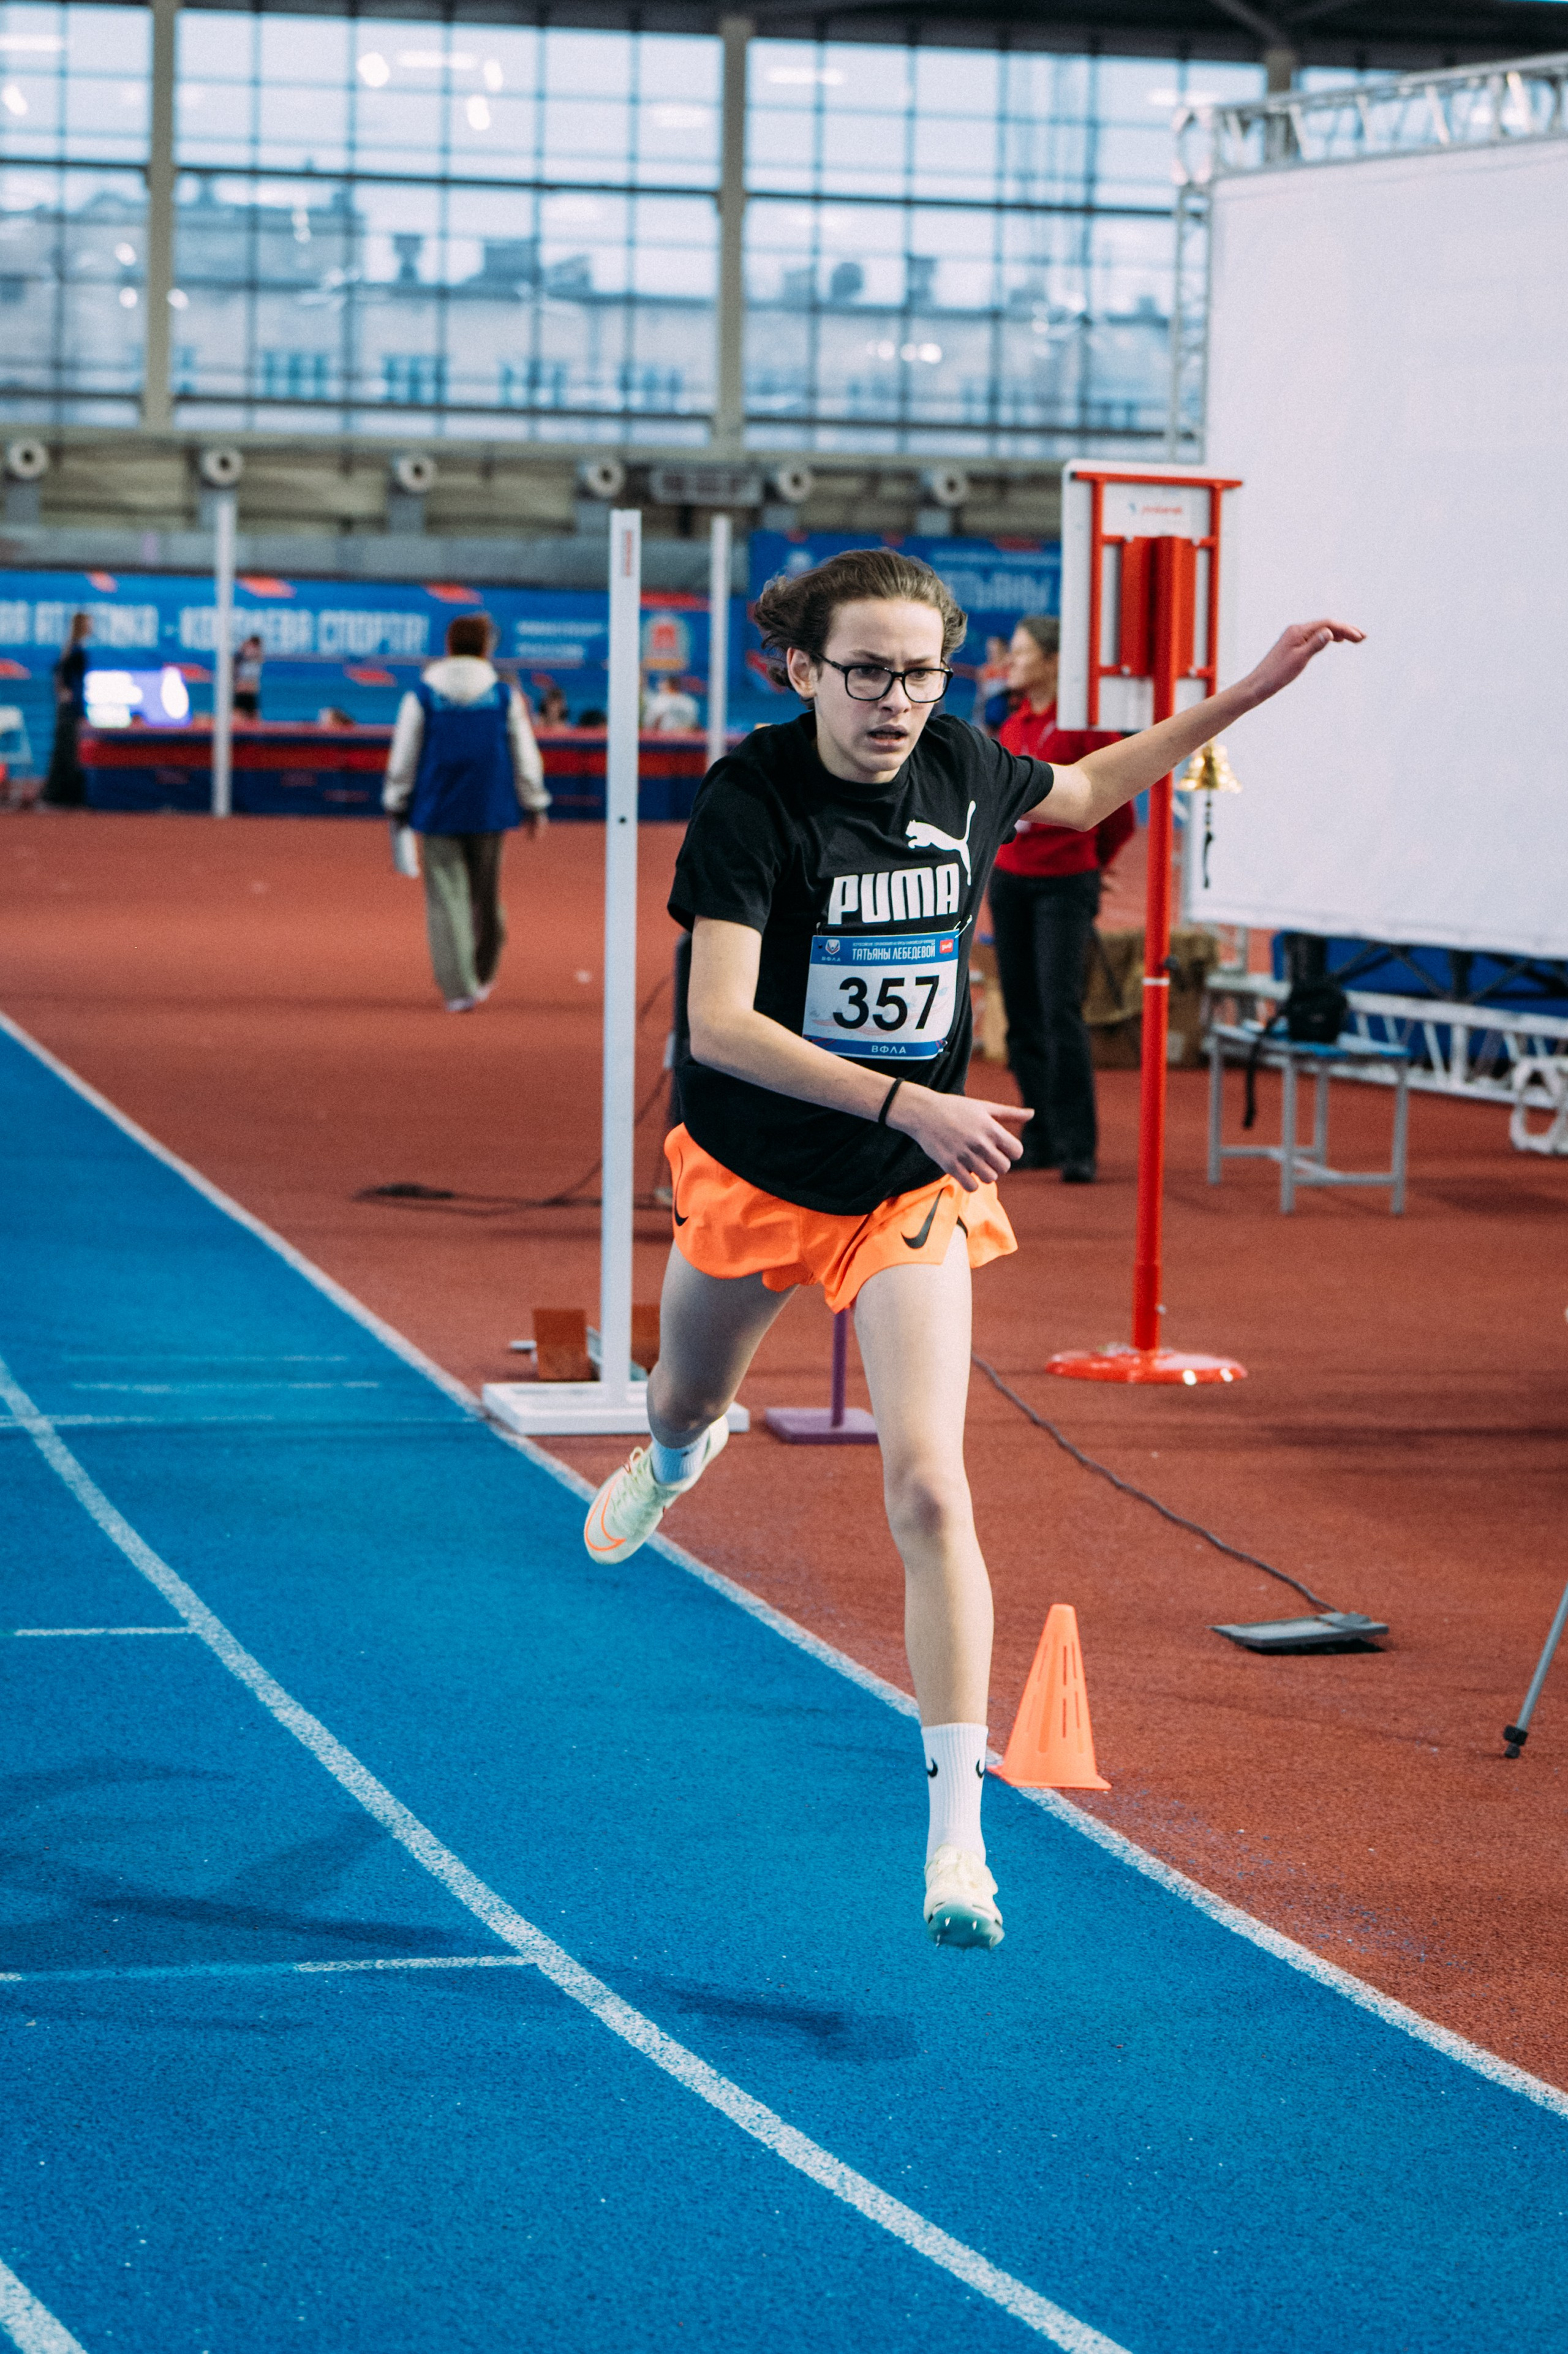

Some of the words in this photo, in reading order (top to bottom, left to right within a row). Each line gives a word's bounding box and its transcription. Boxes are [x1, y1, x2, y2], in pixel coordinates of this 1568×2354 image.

[827, 863, 960, 924] PUMA
[852, 948, 891, 960] ТАТЬЯНЫ
[892, 943, 936, 960] ЛЕБЕДЕВОЙ
[832, 975, 940, 1032] 357
[871, 1045, 907, 1054] ВФЛА
